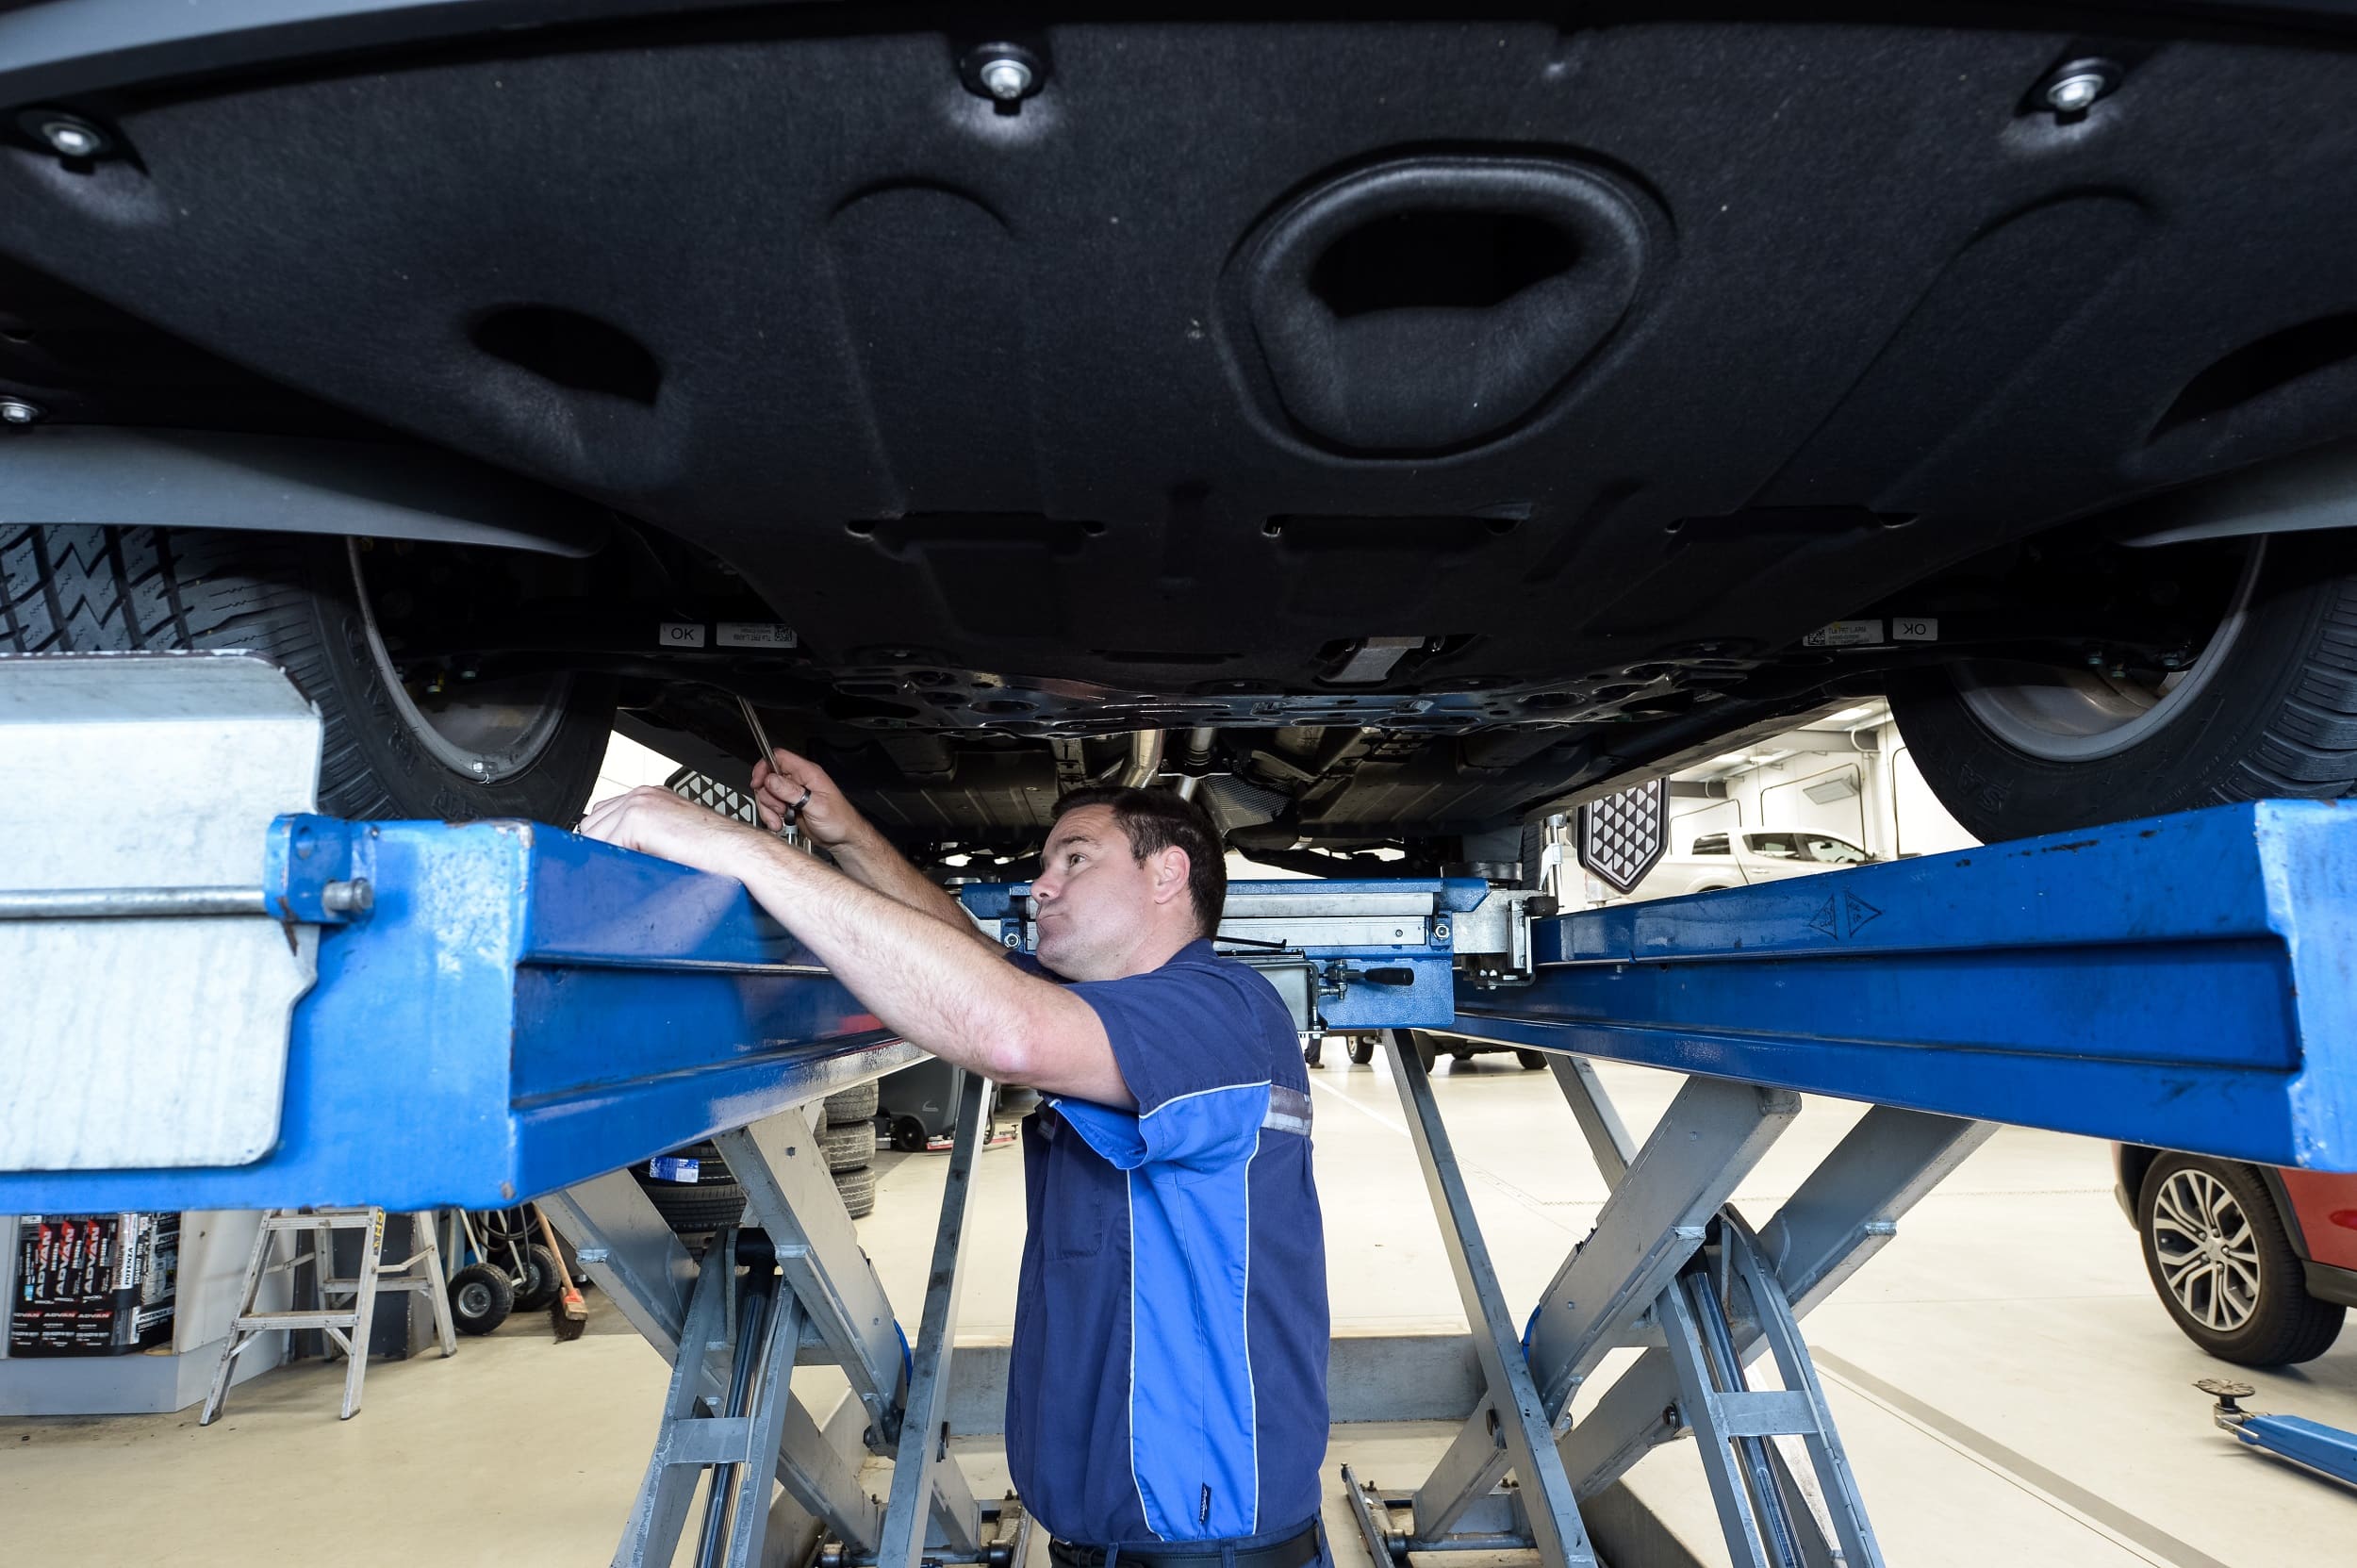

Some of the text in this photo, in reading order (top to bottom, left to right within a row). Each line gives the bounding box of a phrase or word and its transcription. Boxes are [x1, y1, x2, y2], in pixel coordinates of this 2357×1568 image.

[670, 627, 695, 641] OK
[1904, 623, 1926, 635] OK
[36, 1230, 52, 1298] ADVAN
[56, 1228, 75, 1296] ADVAN
[84, 1226, 100, 1294] ADVAN
[124, 1246, 134, 1285] POTENZA
